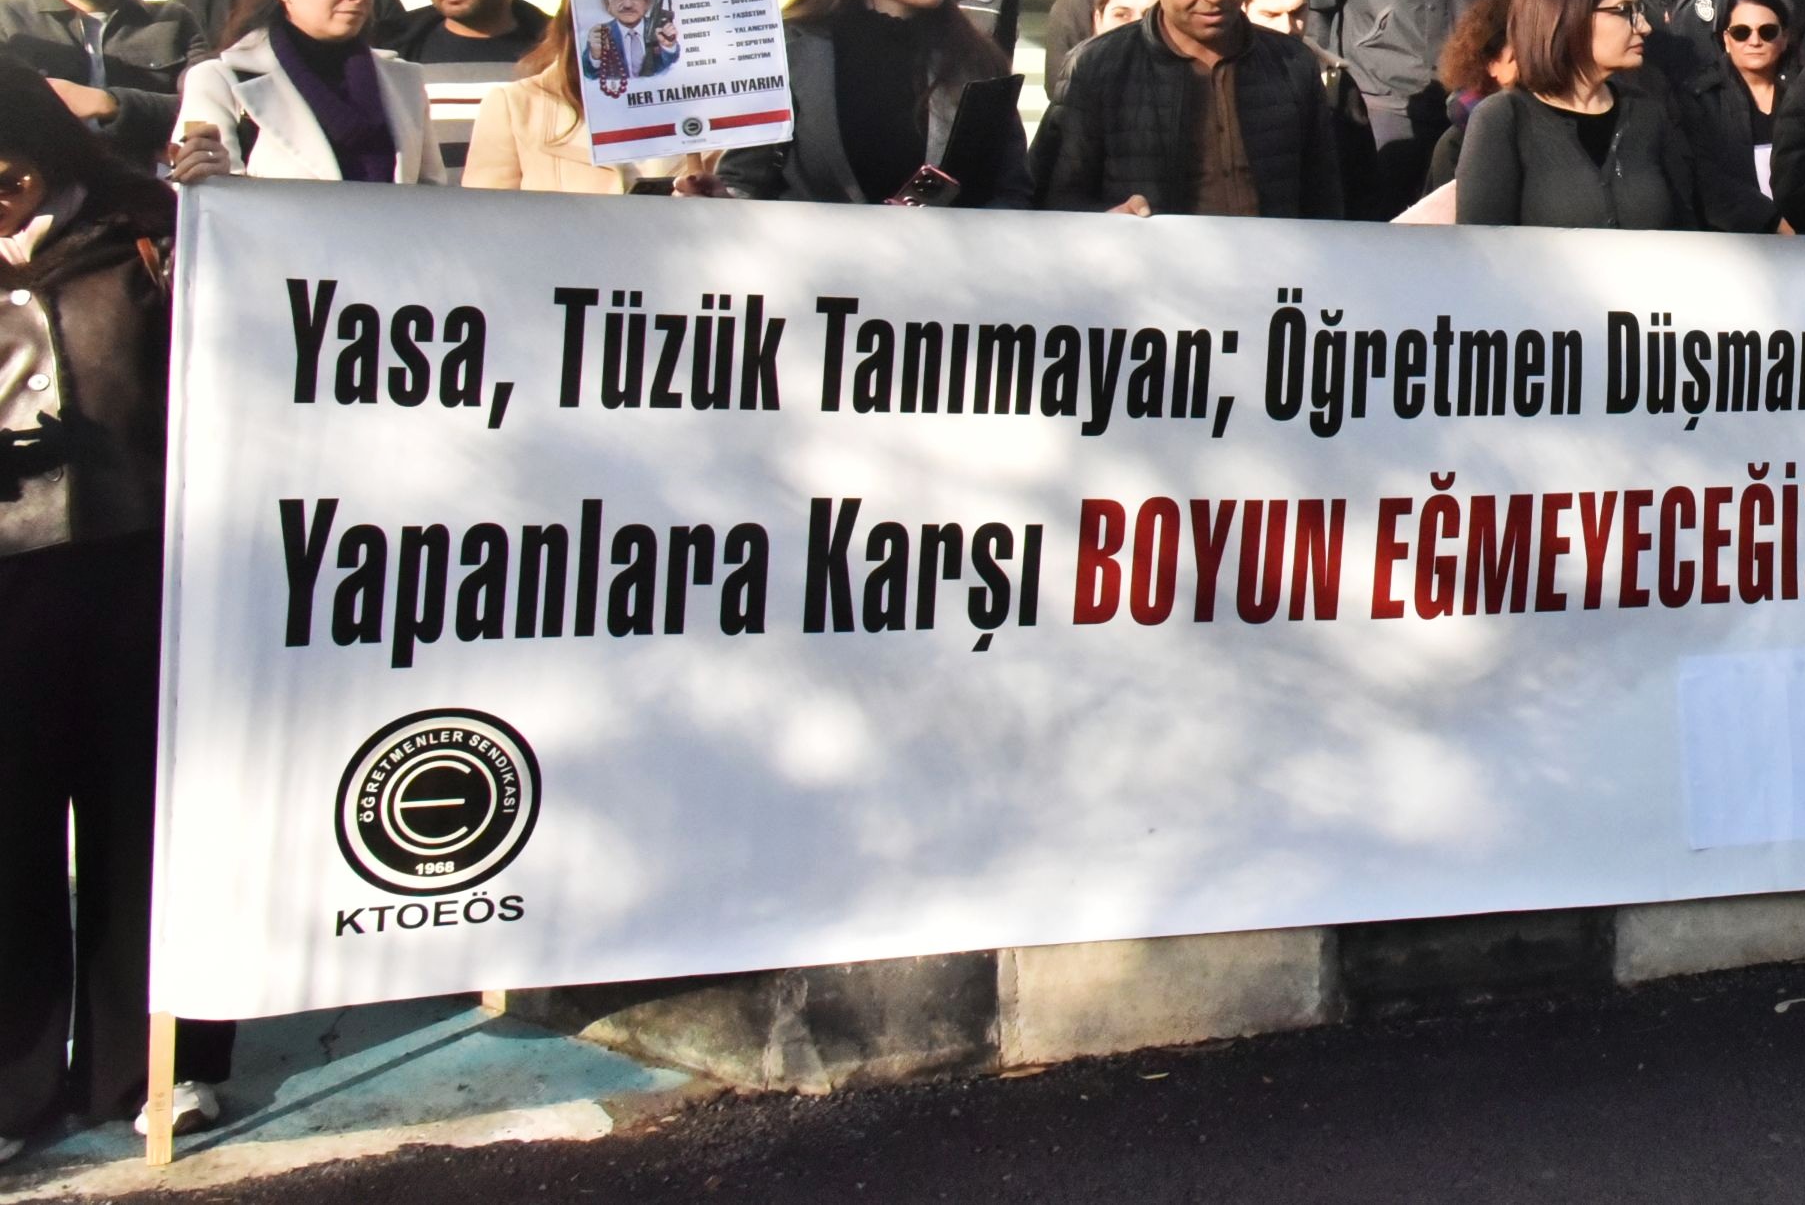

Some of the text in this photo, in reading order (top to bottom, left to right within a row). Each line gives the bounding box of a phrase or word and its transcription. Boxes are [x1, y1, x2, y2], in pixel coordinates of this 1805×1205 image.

[627, 75, 785, 107] HER TALİMATA UYARIM
[287, 279, 514, 429] Yasa,
[554, 287, 786, 411] Tüzük
[816, 297, 1238, 438] Tanımayan;
[1264, 287, 1582, 438] Öğretmen
[279, 498, 769, 668] Yapanlara
[803, 498, 1043, 652] Karşı
[1073, 497, 1346, 625] BOYUN
[359, 730, 464, 823] ÖĞRETMENLER
[415, 861, 455, 875] 1968
[335, 891, 525, 937] KTOEÖS
